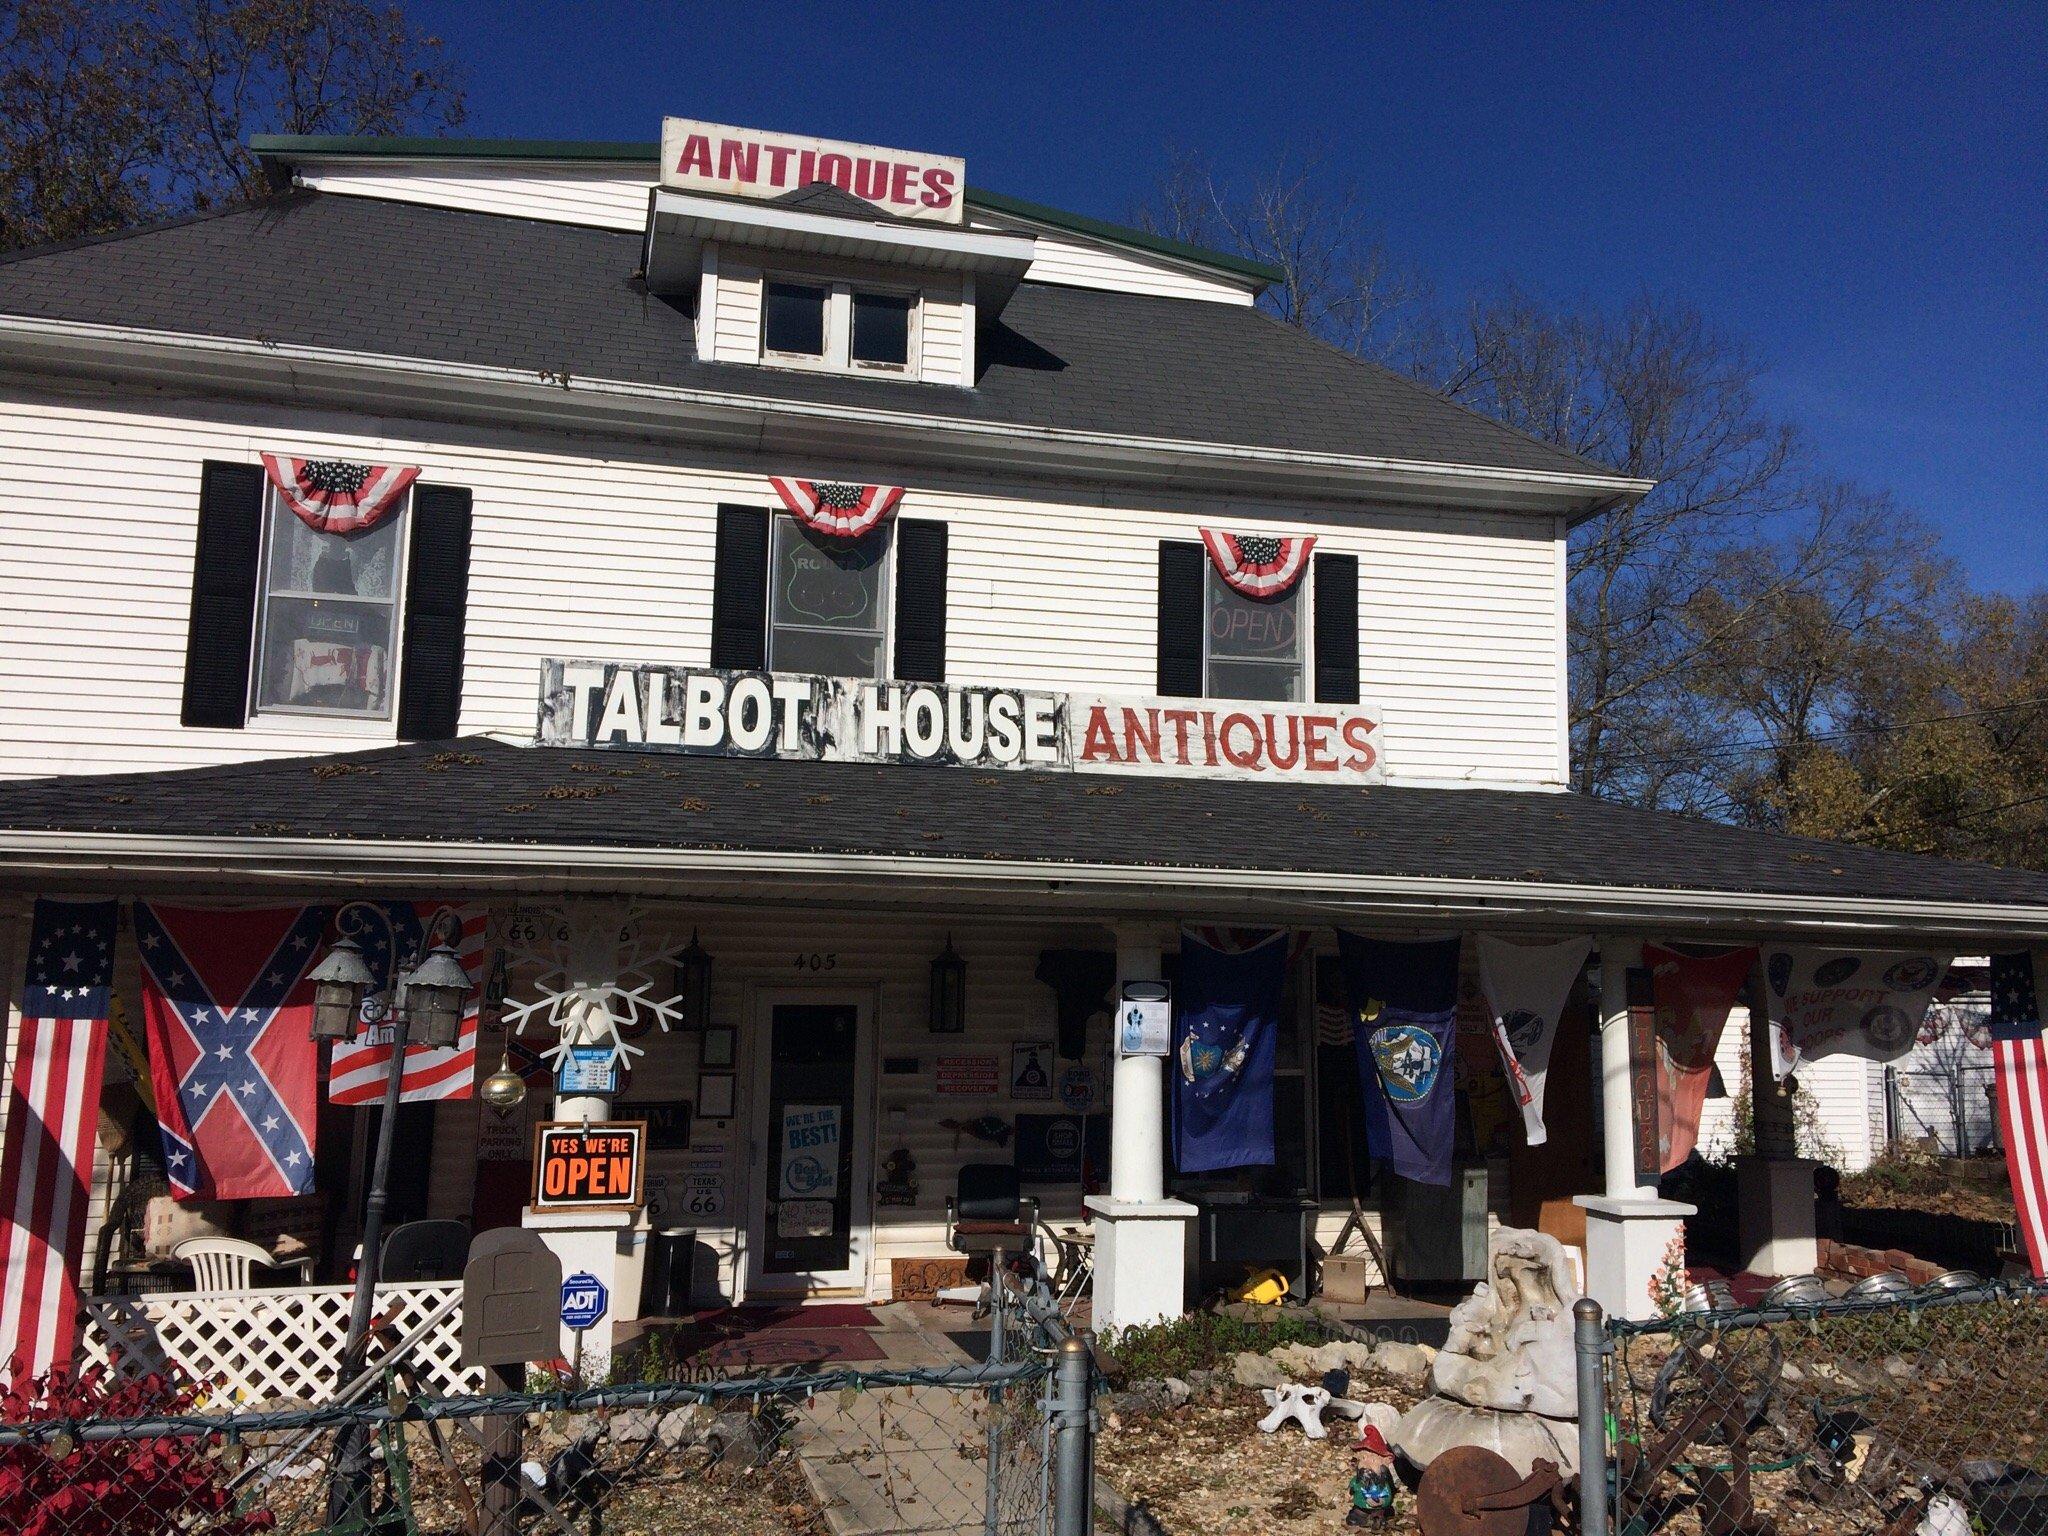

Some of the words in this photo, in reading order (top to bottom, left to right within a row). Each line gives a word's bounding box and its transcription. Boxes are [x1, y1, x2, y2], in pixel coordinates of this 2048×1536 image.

[675, 133, 955, 209] ANTIQUES
[1211, 606, 1284, 642] OPEN
[563, 667, 811, 751] TALBOT
[862, 685, 1058, 762] HOUSE
[1080, 704, 1378, 772] ANTIQUES
[508, 924, 536, 941] 66
[793, 953, 837, 971] 405
[1802, 989, 1890, 1006] SUPPORT
[1803, 1008, 1834, 1027] OUR
[785, 1111, 814, 1127] WE'RE
[817, 1109, 834, 1121] THE
[788, 1123, 838, 1149] BEST!
[551, 1138, 578, 1154] YES
[584, 1138, 629, 1154] WE'RE
[545, 1157, 631, 1196] OPEN
[693, 1177, 717, 1186] TEXAS
[690, 1196, 716, 1213] 66
[563, 1290, 598, 1310] ADT
